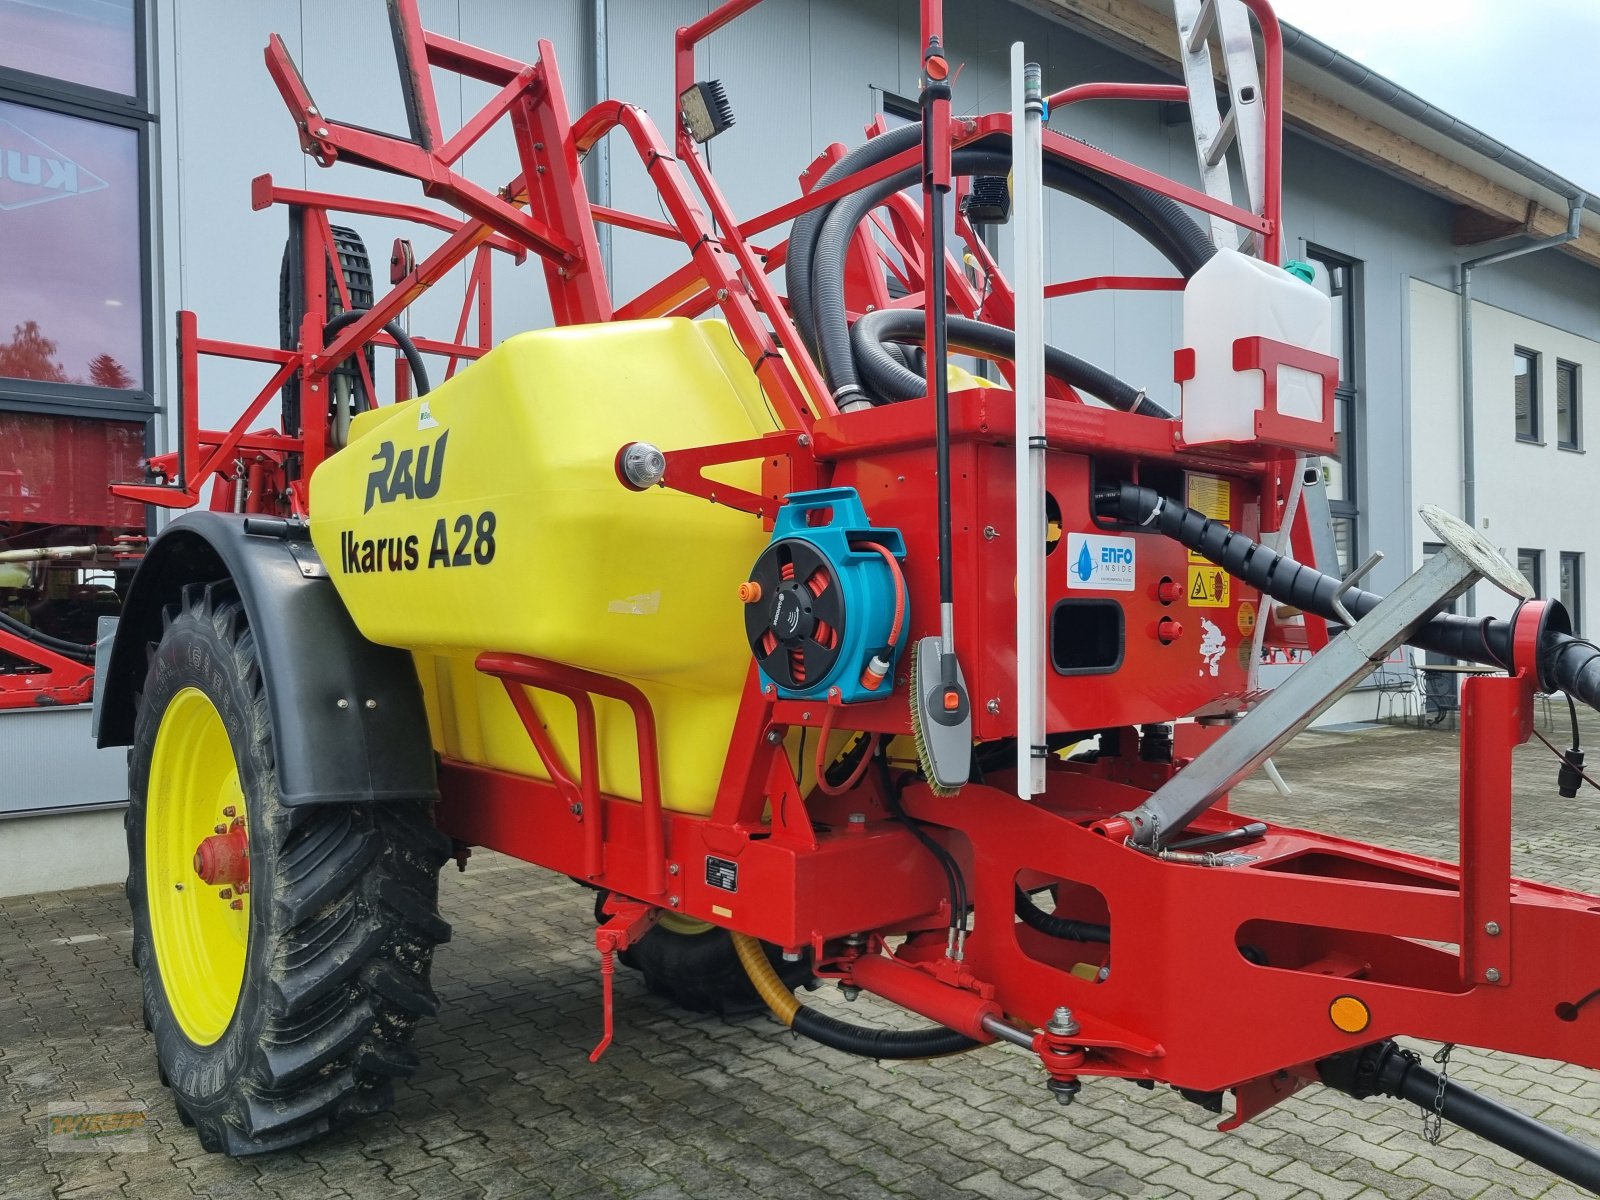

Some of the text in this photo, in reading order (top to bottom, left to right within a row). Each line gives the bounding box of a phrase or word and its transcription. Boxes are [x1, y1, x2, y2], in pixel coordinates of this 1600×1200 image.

[363, 428, 449, 515] RAU
[341, 511, 496, 573] Ikarus A28
[1101, 547, 1133, 564] ENFO
[1101, 564, 1132, 573] INSIDE
